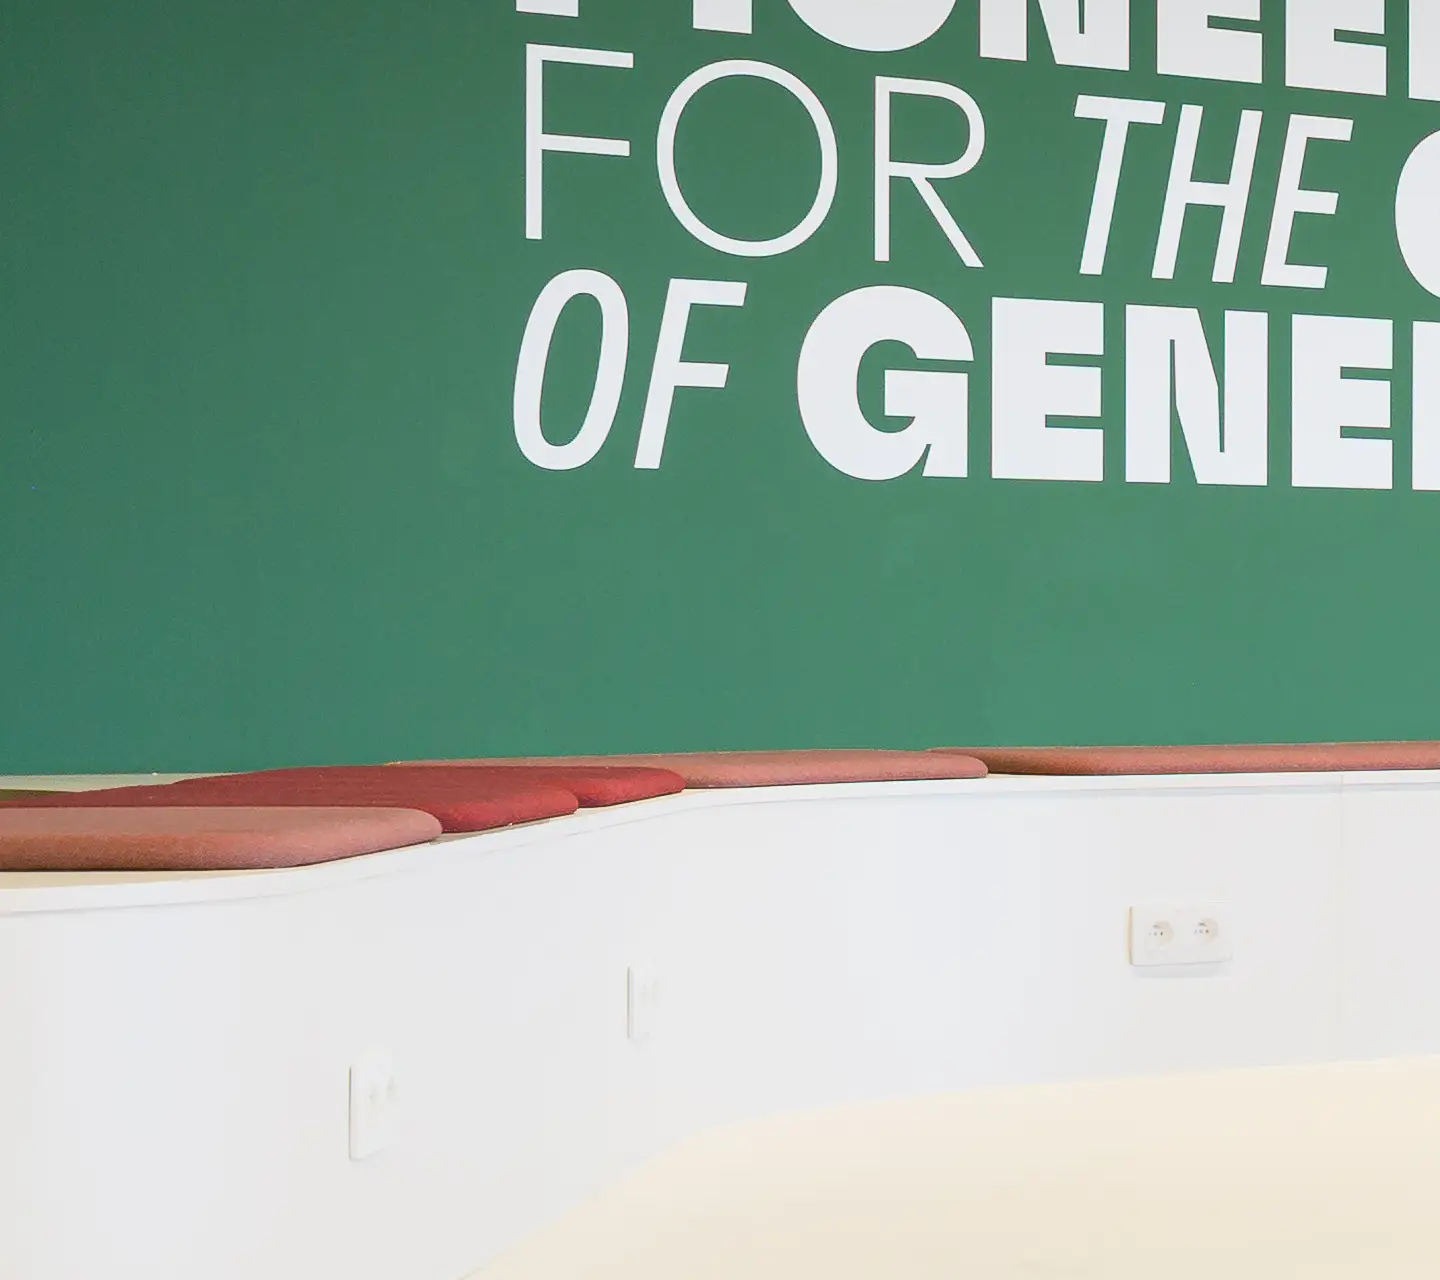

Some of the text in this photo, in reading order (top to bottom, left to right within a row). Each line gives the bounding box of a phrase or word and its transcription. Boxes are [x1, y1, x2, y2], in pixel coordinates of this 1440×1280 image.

[526, 44, 985, 267] FOR
[1074, 95, 1353, 288] THE
[514, 270, 747, 469] OF
